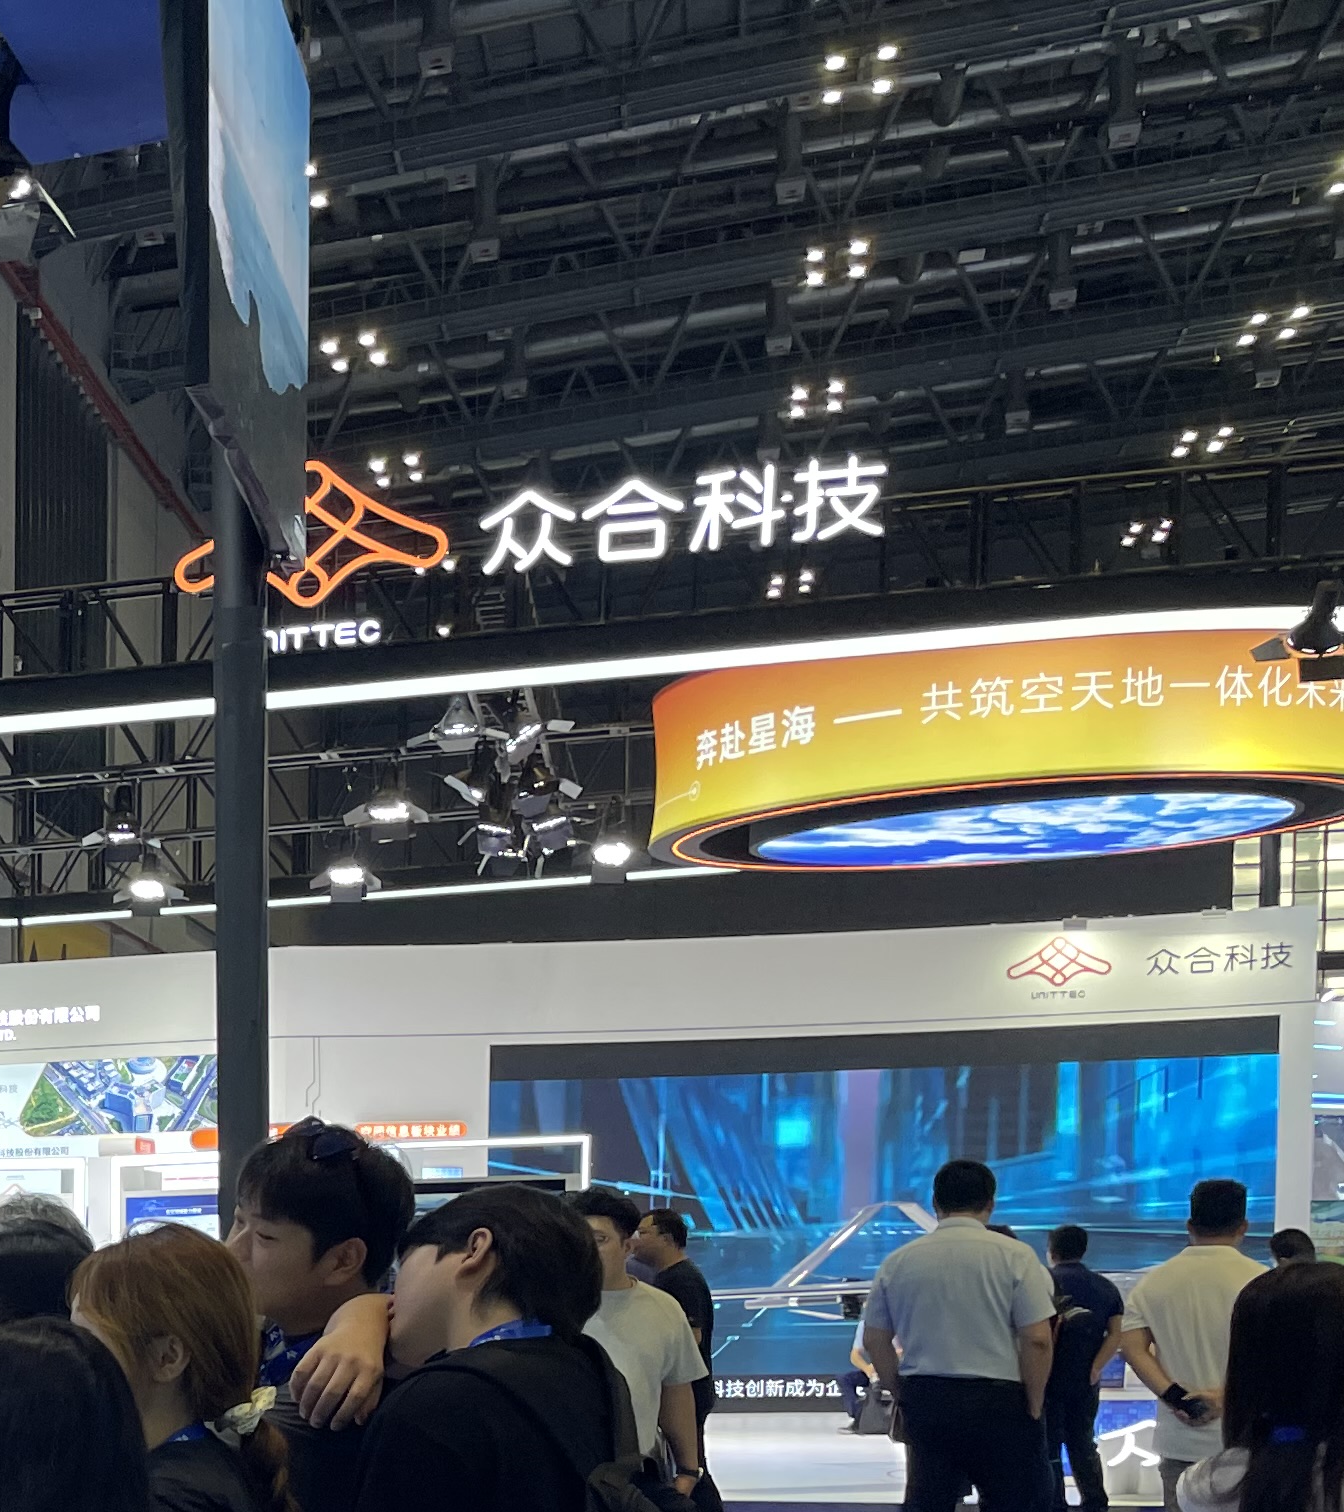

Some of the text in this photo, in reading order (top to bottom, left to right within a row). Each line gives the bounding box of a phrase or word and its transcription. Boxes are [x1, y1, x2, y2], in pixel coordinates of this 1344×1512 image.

[480, 455, 887, 575] 众合科技
[265, 618, 382, 655] NITTEC
[696, 706, 816, 770] 奔赴星海
[1146, 942, 1294, 976] 众合科技
[714, 1378, 866, 1399] 科技创新成为企
